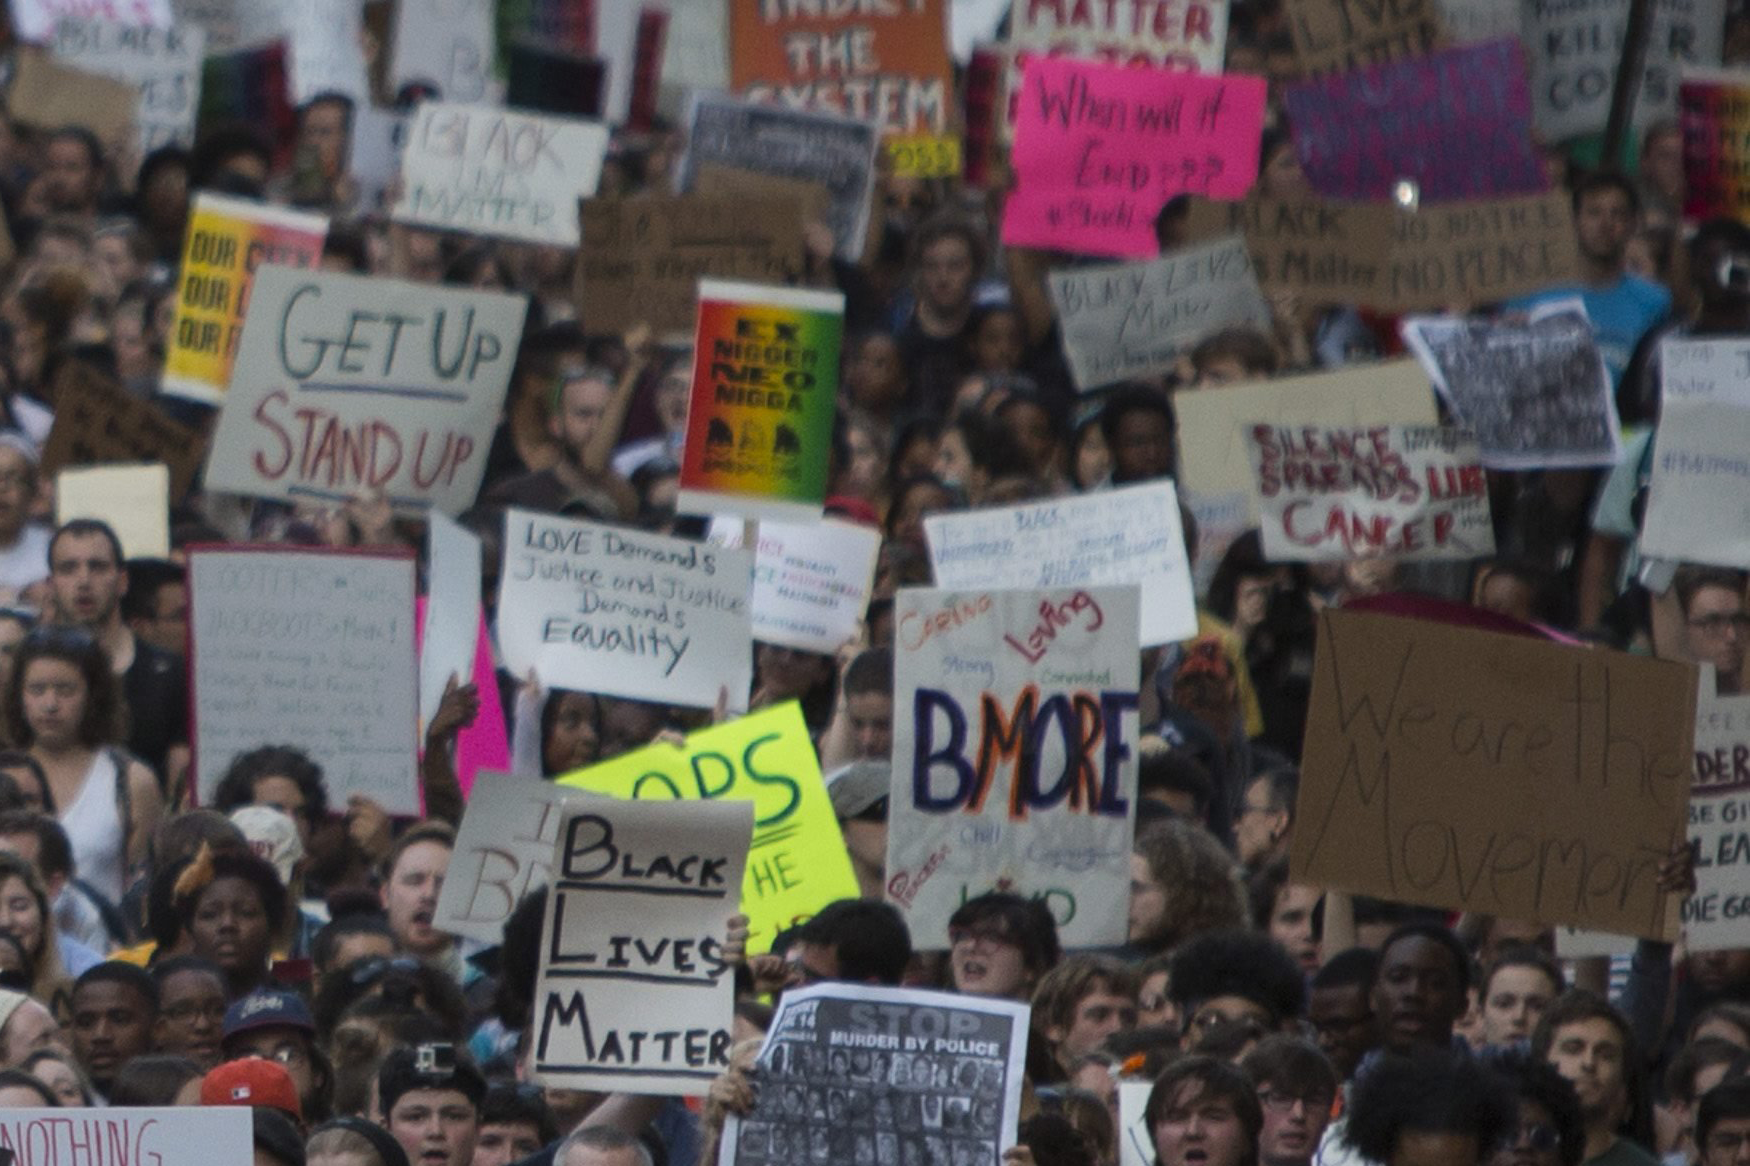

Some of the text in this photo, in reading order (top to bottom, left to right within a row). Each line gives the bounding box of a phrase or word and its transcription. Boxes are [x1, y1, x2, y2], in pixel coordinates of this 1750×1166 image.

[784, 26, 880, 77] THE
[1547, 66, 1668, 112] COS
[192, 230, 237, 269] OUR
[185, 275, 231, 313] OUR
[178, 318, 222, 355] OUR
[280, 283, 501, 381] GET UP
[252, 389, 473, 488] STAND UP
[525, 521, 592, 554] LOVE
[602, 530, 717, 575] Demands
[1282, 498, 1472, 557] CANCER
[612, 570, 656, 594] and
[1004, 590, 1103, 664] Loving
[1324, 611, 1681, 812] We are the
[913, 682, 1139, 823] BMORE
[560, 814, 728, 888] BLACK
[549, 893, 730, 978] LIVES
[536, 989, 732, 1067] MATTER
[829, 1030, 900, 1051] MURDER
[904, 1036, 928, 1052] BY
[934, 1037, 1001, 1056] POLICE
[849, 1002, 982, 1040] STOP
